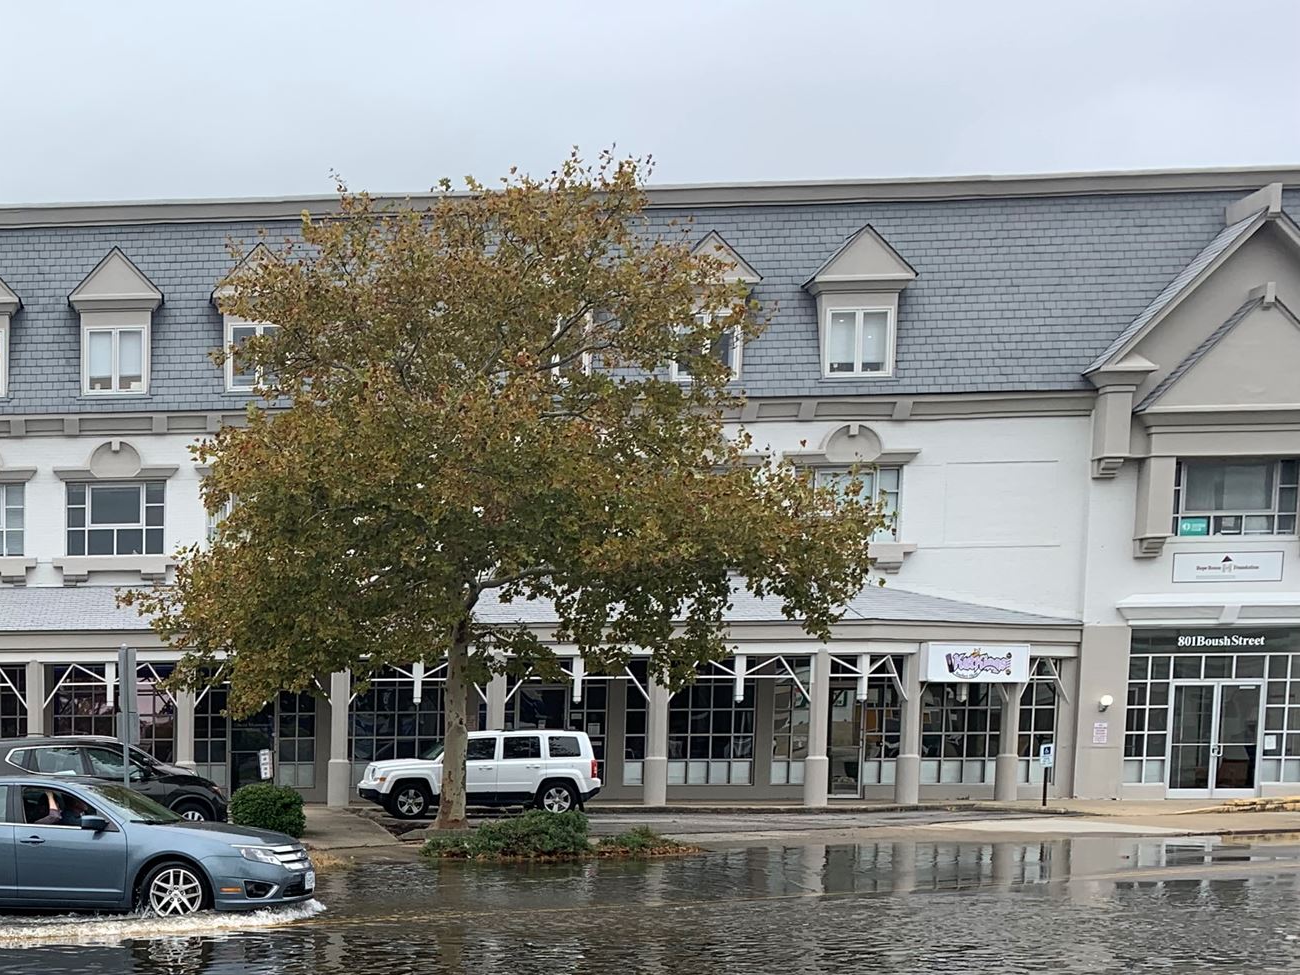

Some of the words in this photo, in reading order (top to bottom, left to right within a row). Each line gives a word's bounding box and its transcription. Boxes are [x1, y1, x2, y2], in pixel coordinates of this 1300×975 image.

[1177, 635, 1196, 646] 801
[1197, 635, 1230, 646] Boush
[1231, 634, 1266, 646] Street
